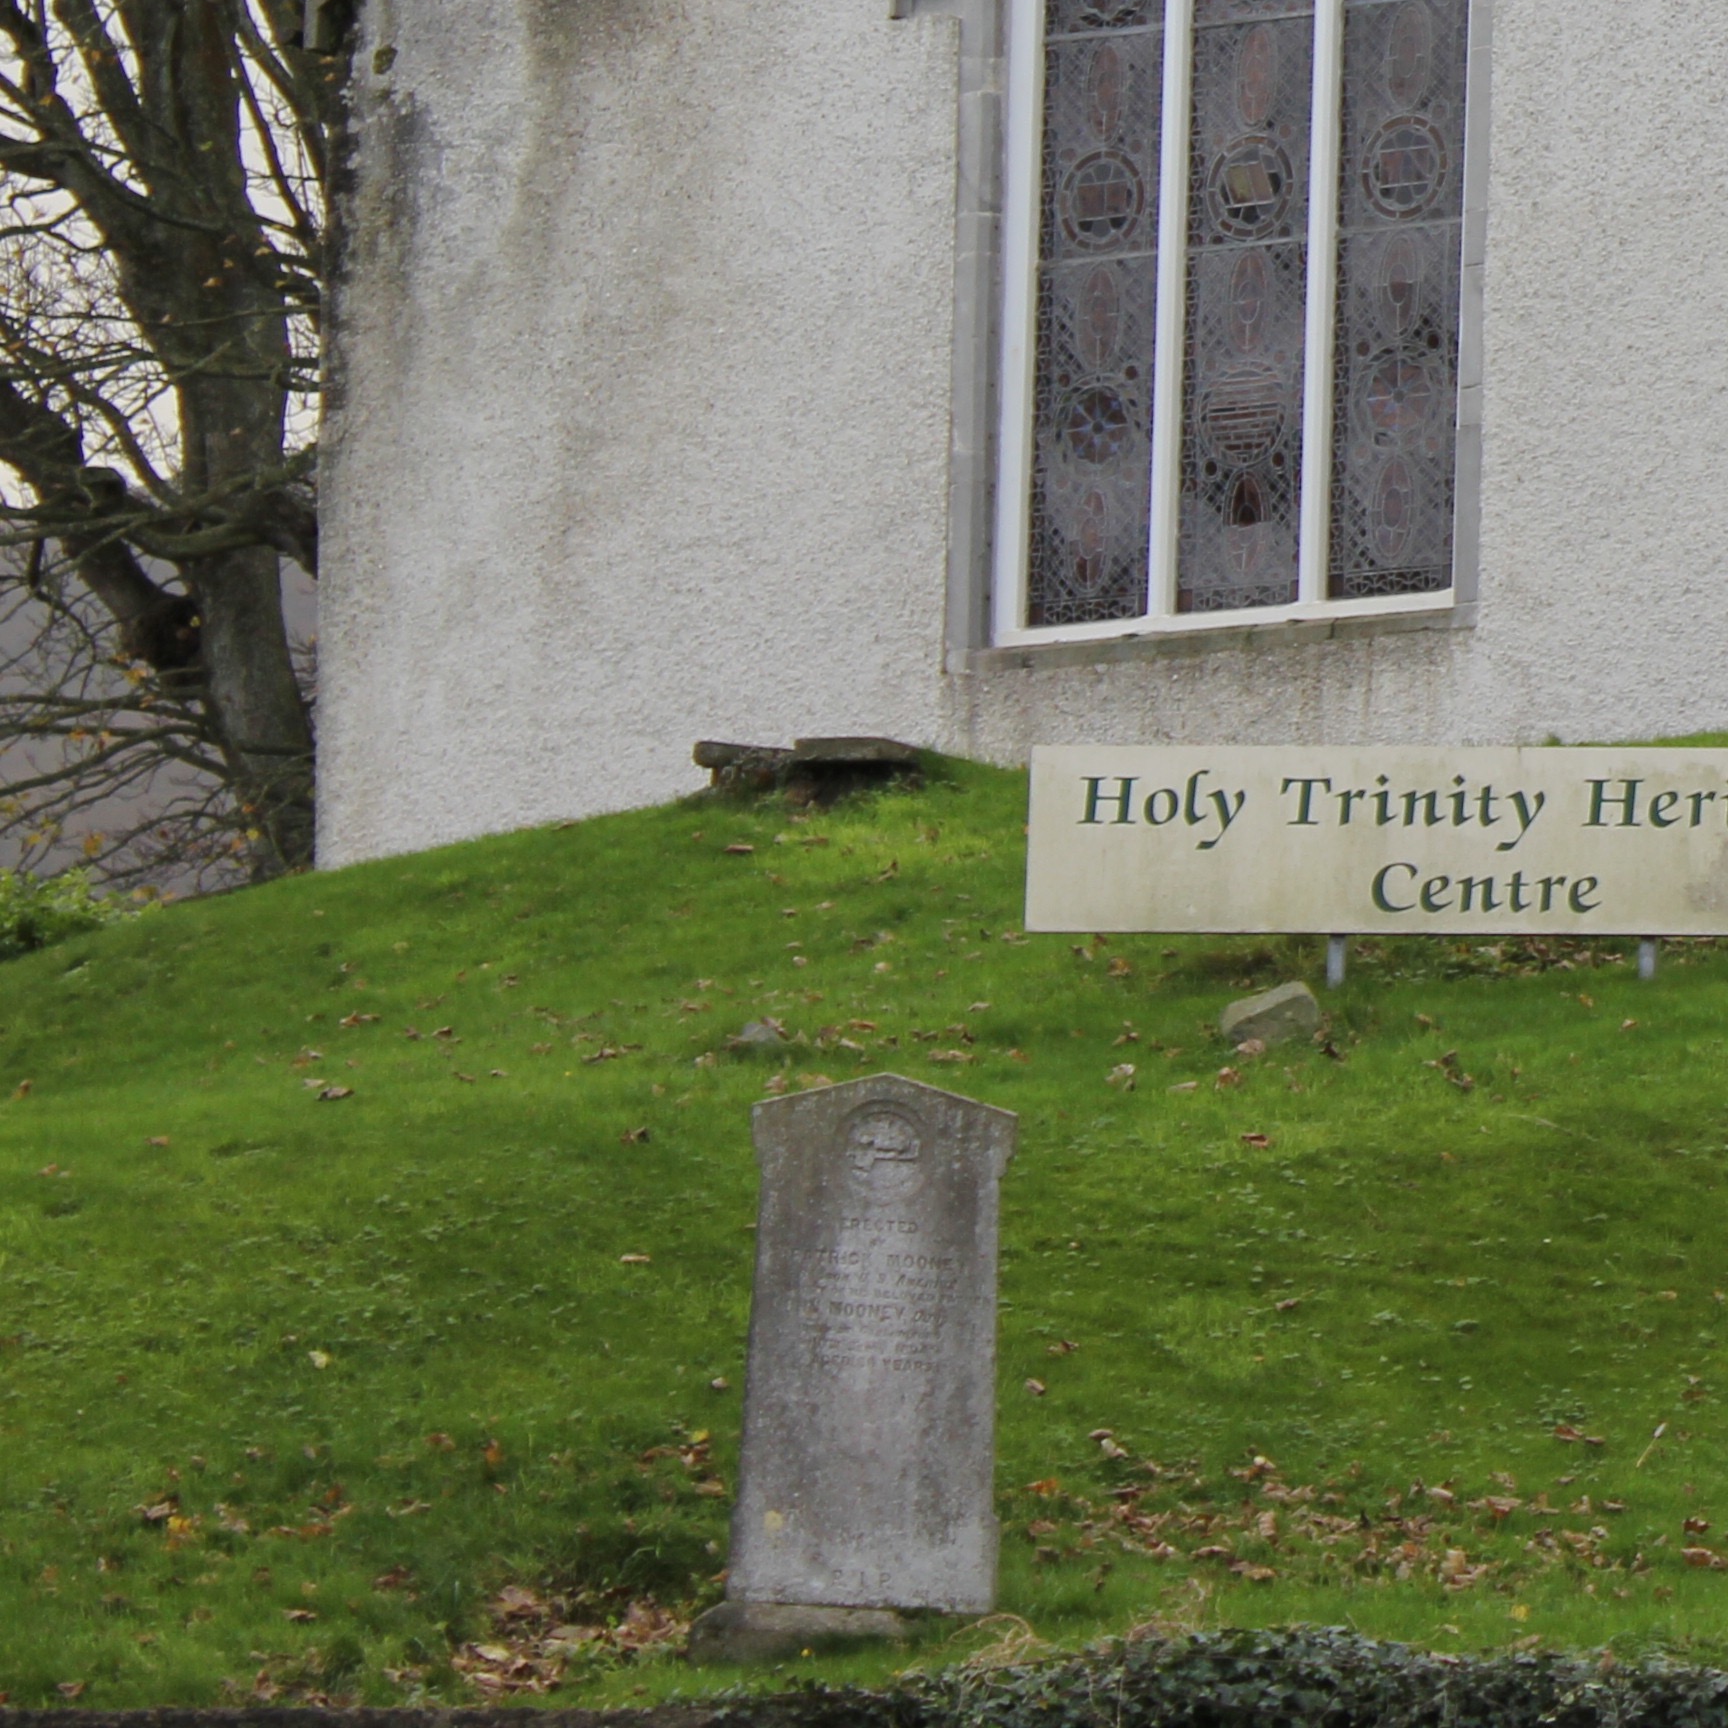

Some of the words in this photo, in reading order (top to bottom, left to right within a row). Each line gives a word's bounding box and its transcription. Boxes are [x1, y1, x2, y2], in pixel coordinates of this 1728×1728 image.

[1076, 770, 1246, 850] Holy
[1280, 774, 1546, 852] Trinity
[1370, 863, 1603, 915] Centre
